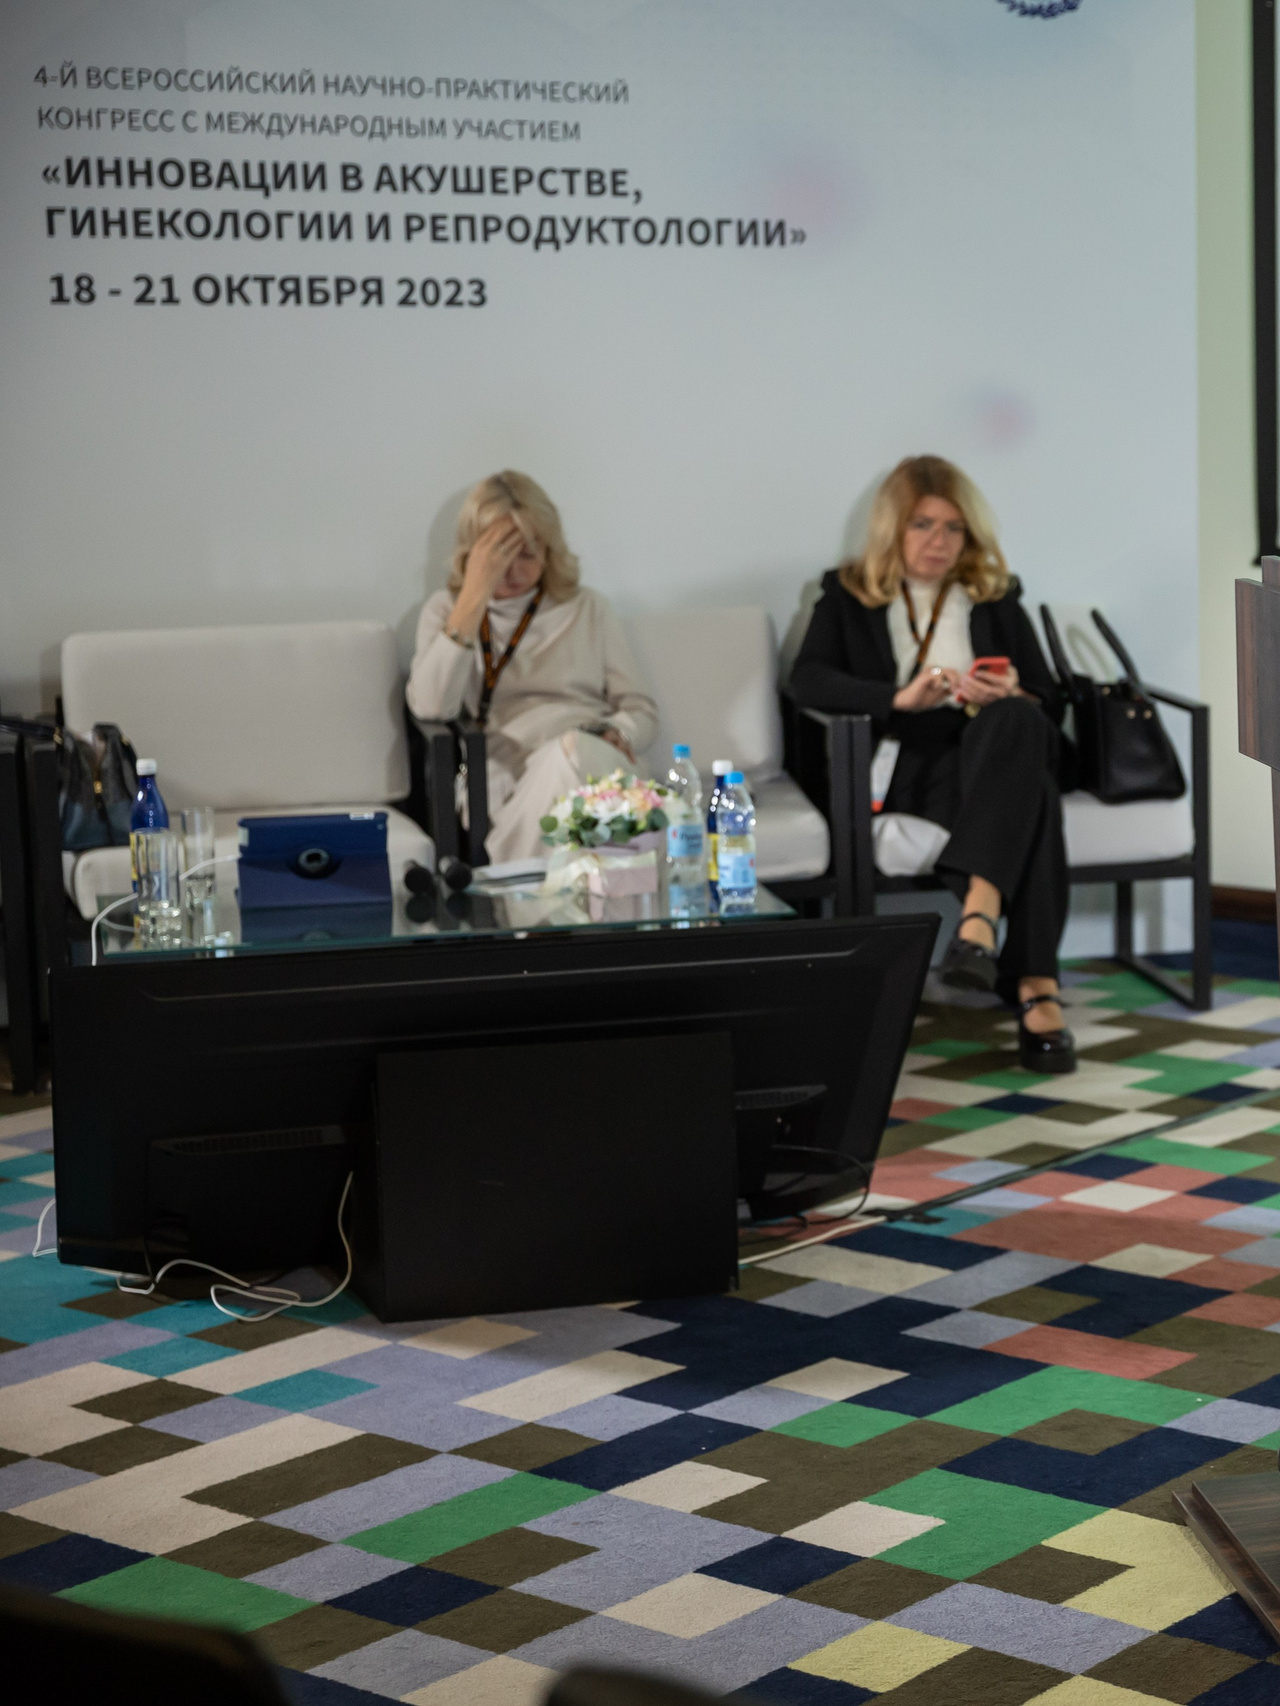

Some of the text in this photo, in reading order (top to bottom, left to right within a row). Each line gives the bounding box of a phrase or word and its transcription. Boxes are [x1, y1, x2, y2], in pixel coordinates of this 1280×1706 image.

[33, 60, 630, 104] 4-Й ВСЕРОССИЙСКИЙ НАУЧНО-ПРАКТИЧЕСКИЙ
[37, 106, 581, 142] КОНГРЕСС С МЕЖДУНАРОДНЫМ УЧАСТИЕМ
[42, 156, 643, 205] «ИННОВАЦИИ В АКУШЕРСТВЕ,
[45, 206, 807, 252] ГИНЕКОЛОГИИ И РЕПРОДУКТОЛОГИИ»
[49, 273, 97, 306] 18
[133, 274, 181, 306] 21
[192, 273, 385, 307] ОКТЯБРЯ
[397, 277, 488, 308] 2023
